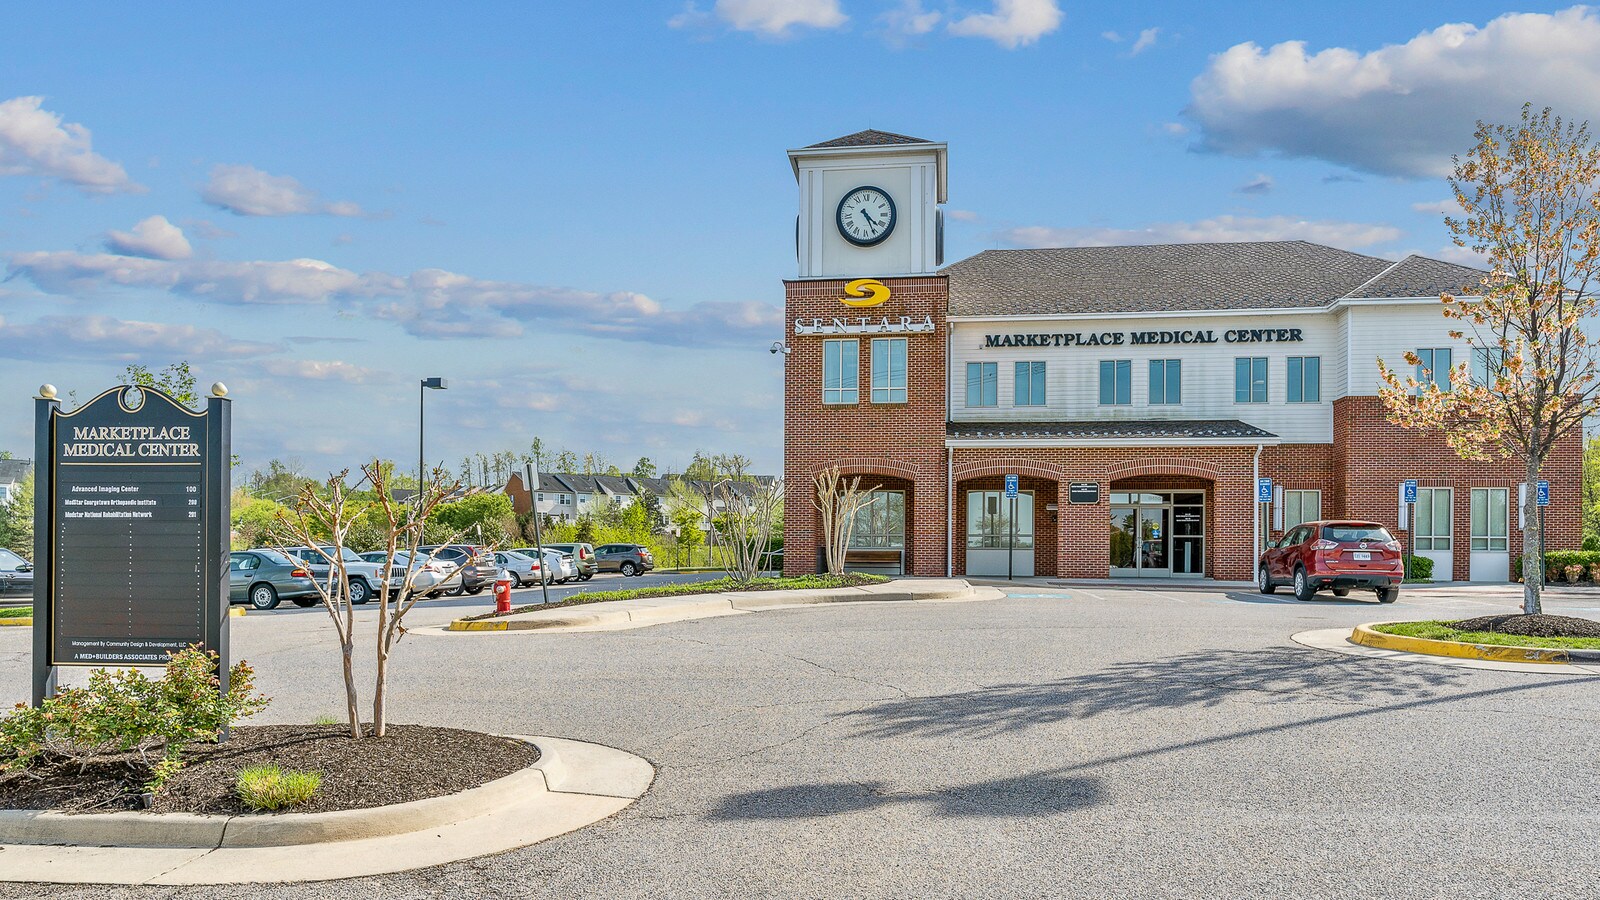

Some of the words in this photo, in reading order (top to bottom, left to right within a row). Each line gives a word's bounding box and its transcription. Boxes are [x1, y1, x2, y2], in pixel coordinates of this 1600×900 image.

[794, 315, 935, 334] SENTARA
[985, 332, 1124, 347] MARKETPLACE
[1130, 330, 1218, 345] MEDICAL
[1224, 328, 1304, 342] CENTER
[73, 426, 190, 440] MARKETPLACE
[63, 443, 136, 457] MEDICAL
[138, 443, 201, 457] CENTER
